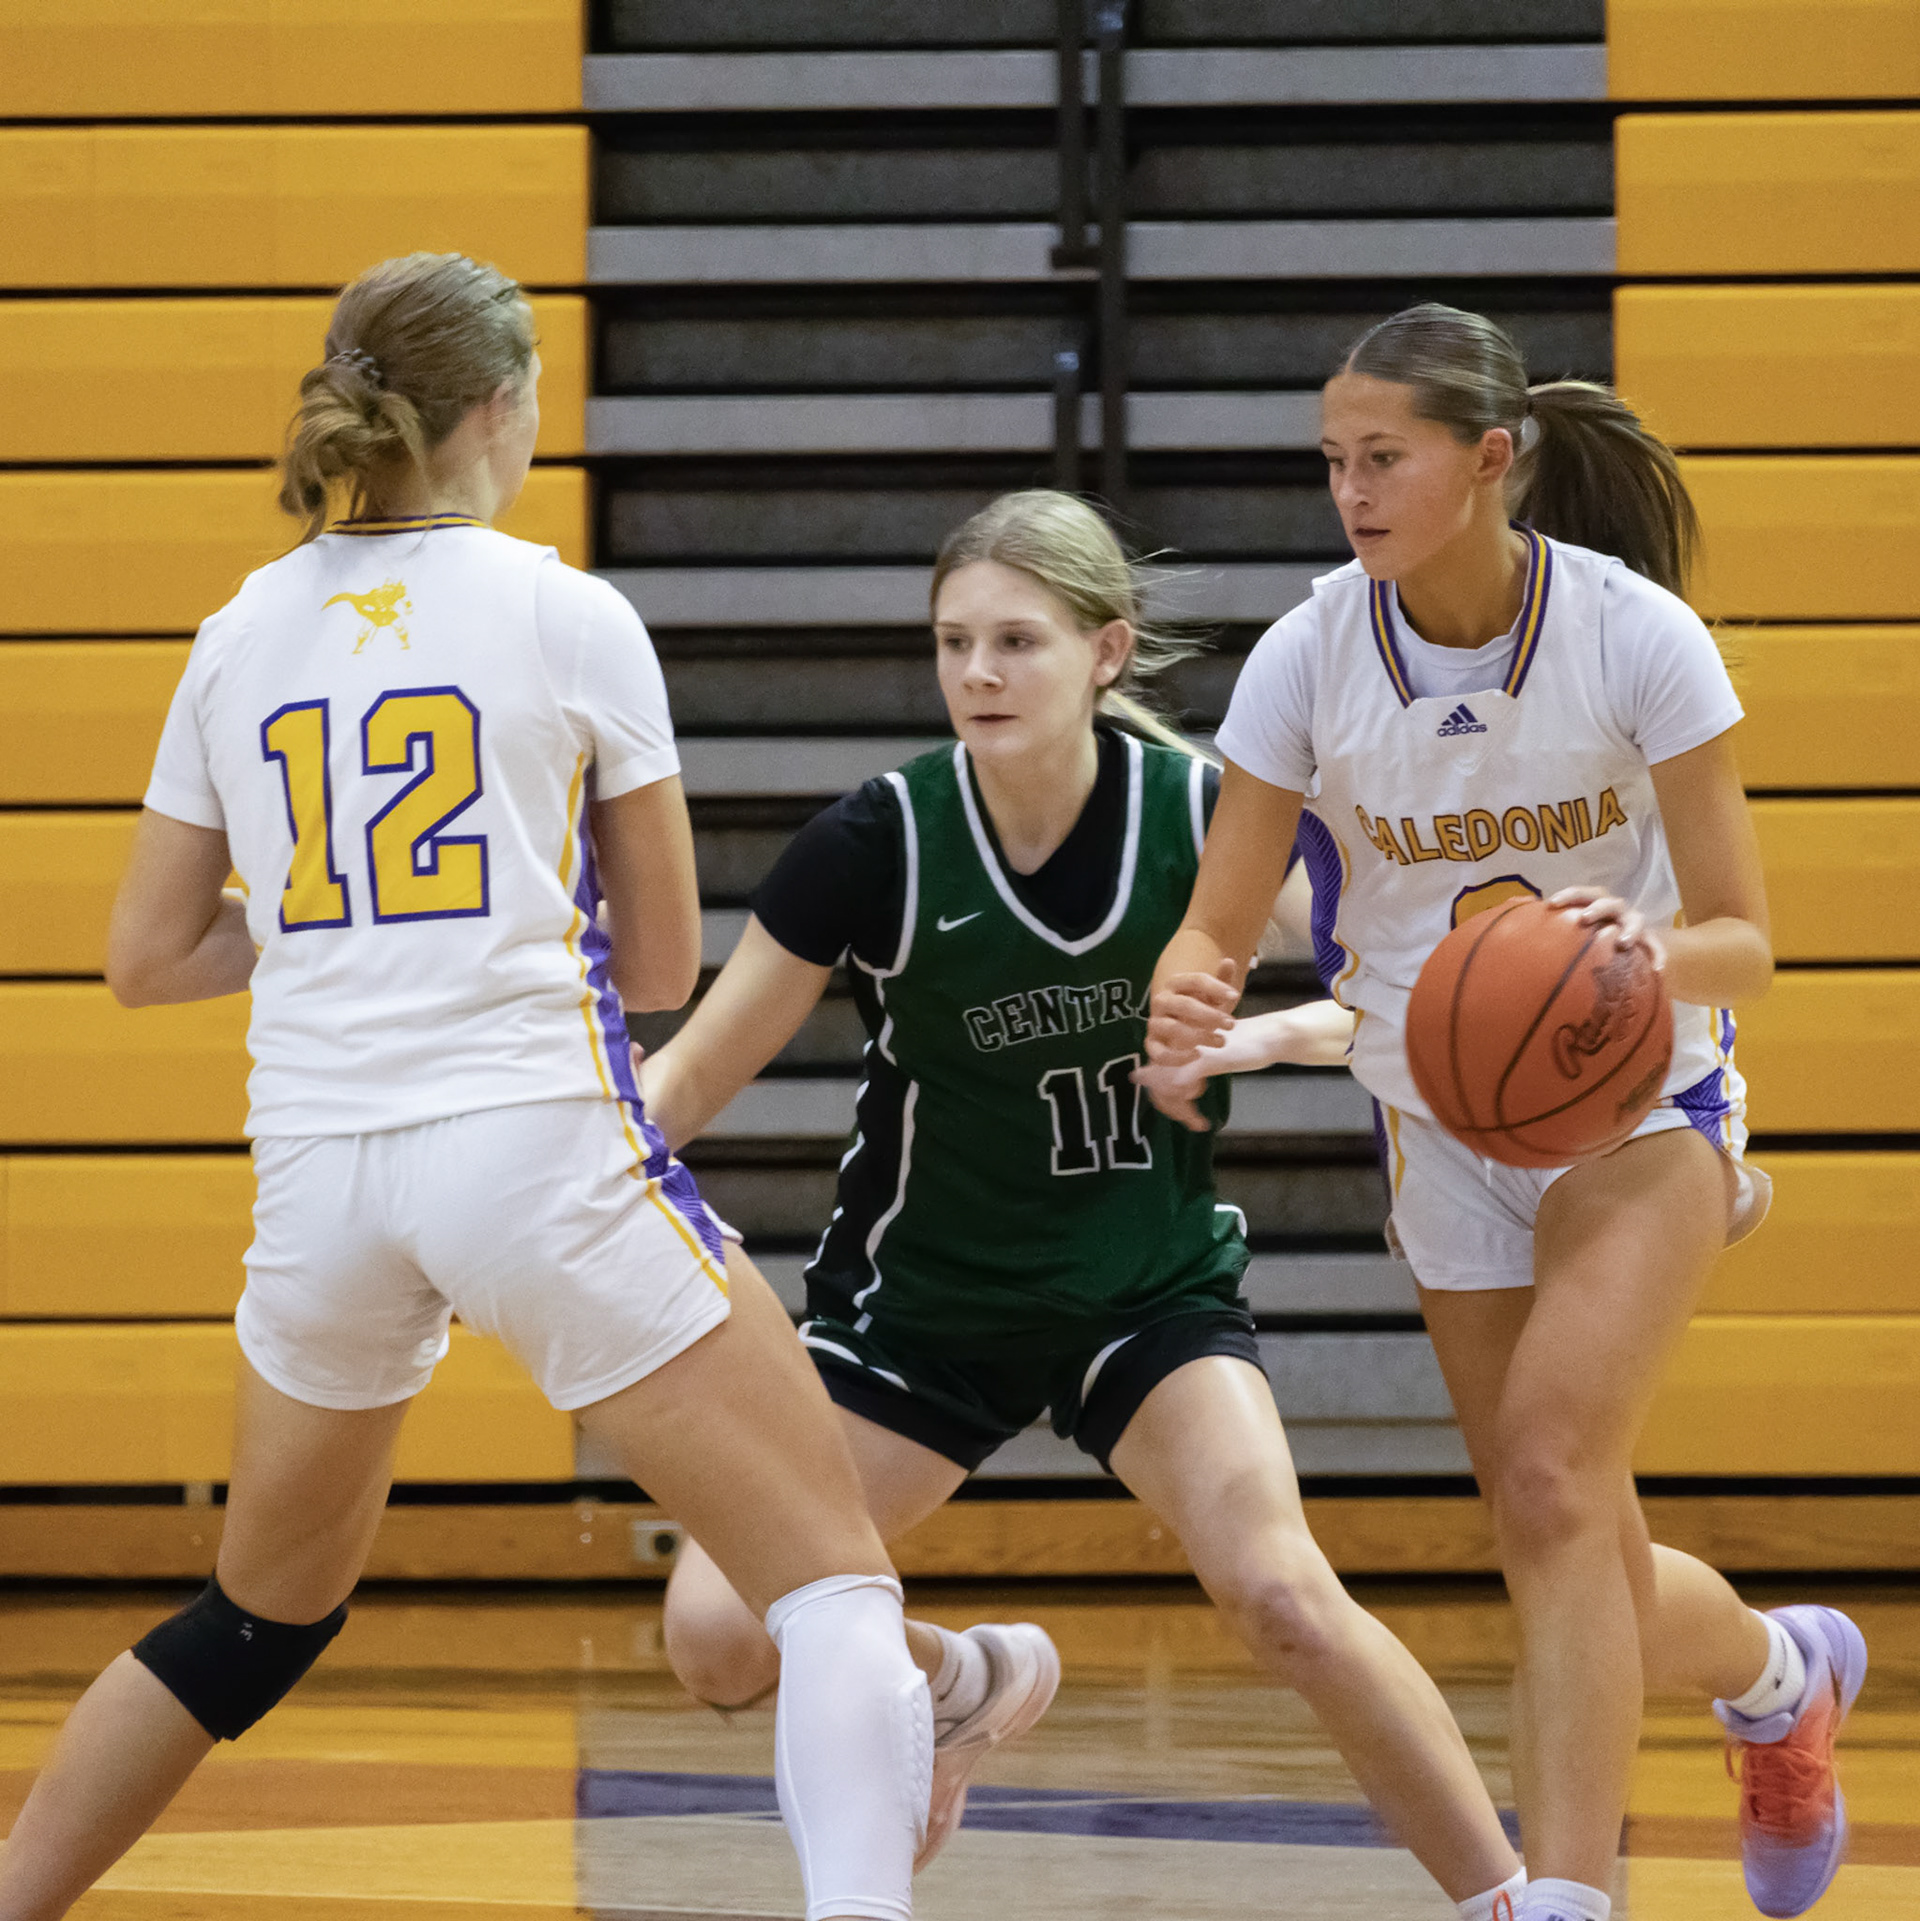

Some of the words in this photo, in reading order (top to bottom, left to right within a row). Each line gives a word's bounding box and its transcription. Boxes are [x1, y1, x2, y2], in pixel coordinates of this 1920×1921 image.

[1437, 721, 1487, 737] adidas
[260, 685, 490, 934] 12
[1355, 787, 1628, 866] CALEDONIA
[1037, 1053, 1152, 1176] 11
